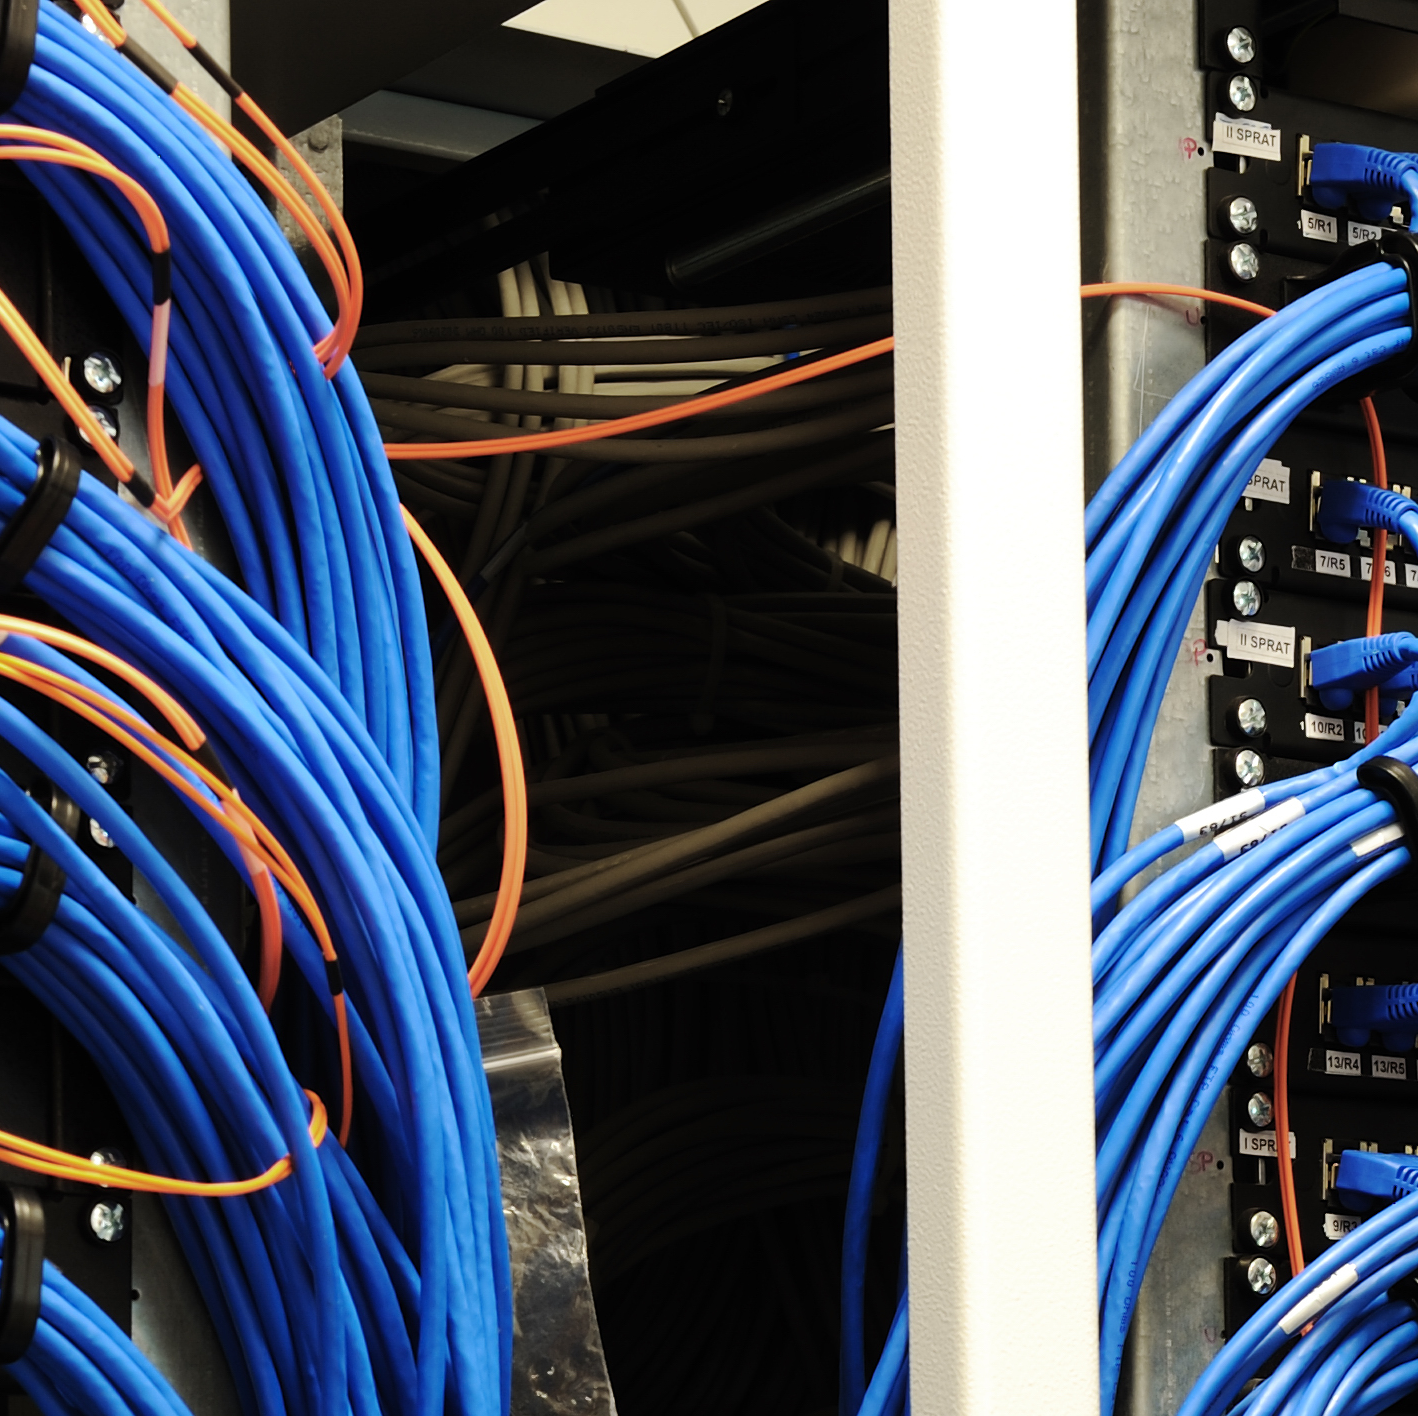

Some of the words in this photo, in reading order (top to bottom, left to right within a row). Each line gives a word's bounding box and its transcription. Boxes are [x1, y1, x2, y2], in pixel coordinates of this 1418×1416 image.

[1237, 128, 1276, 147] SPRAT
[1308, 218, 1332, 234] 5/R1
[1320, 556, 1345, 571] 7/R5
[1250, 637, 1290, 656] SPRAT
[1311, 719, 1343, 736] 10/R2
[1328, 1056, 1359, 1071] 13/R4
[1373, 1061, 1405, 1075] 13/R5
